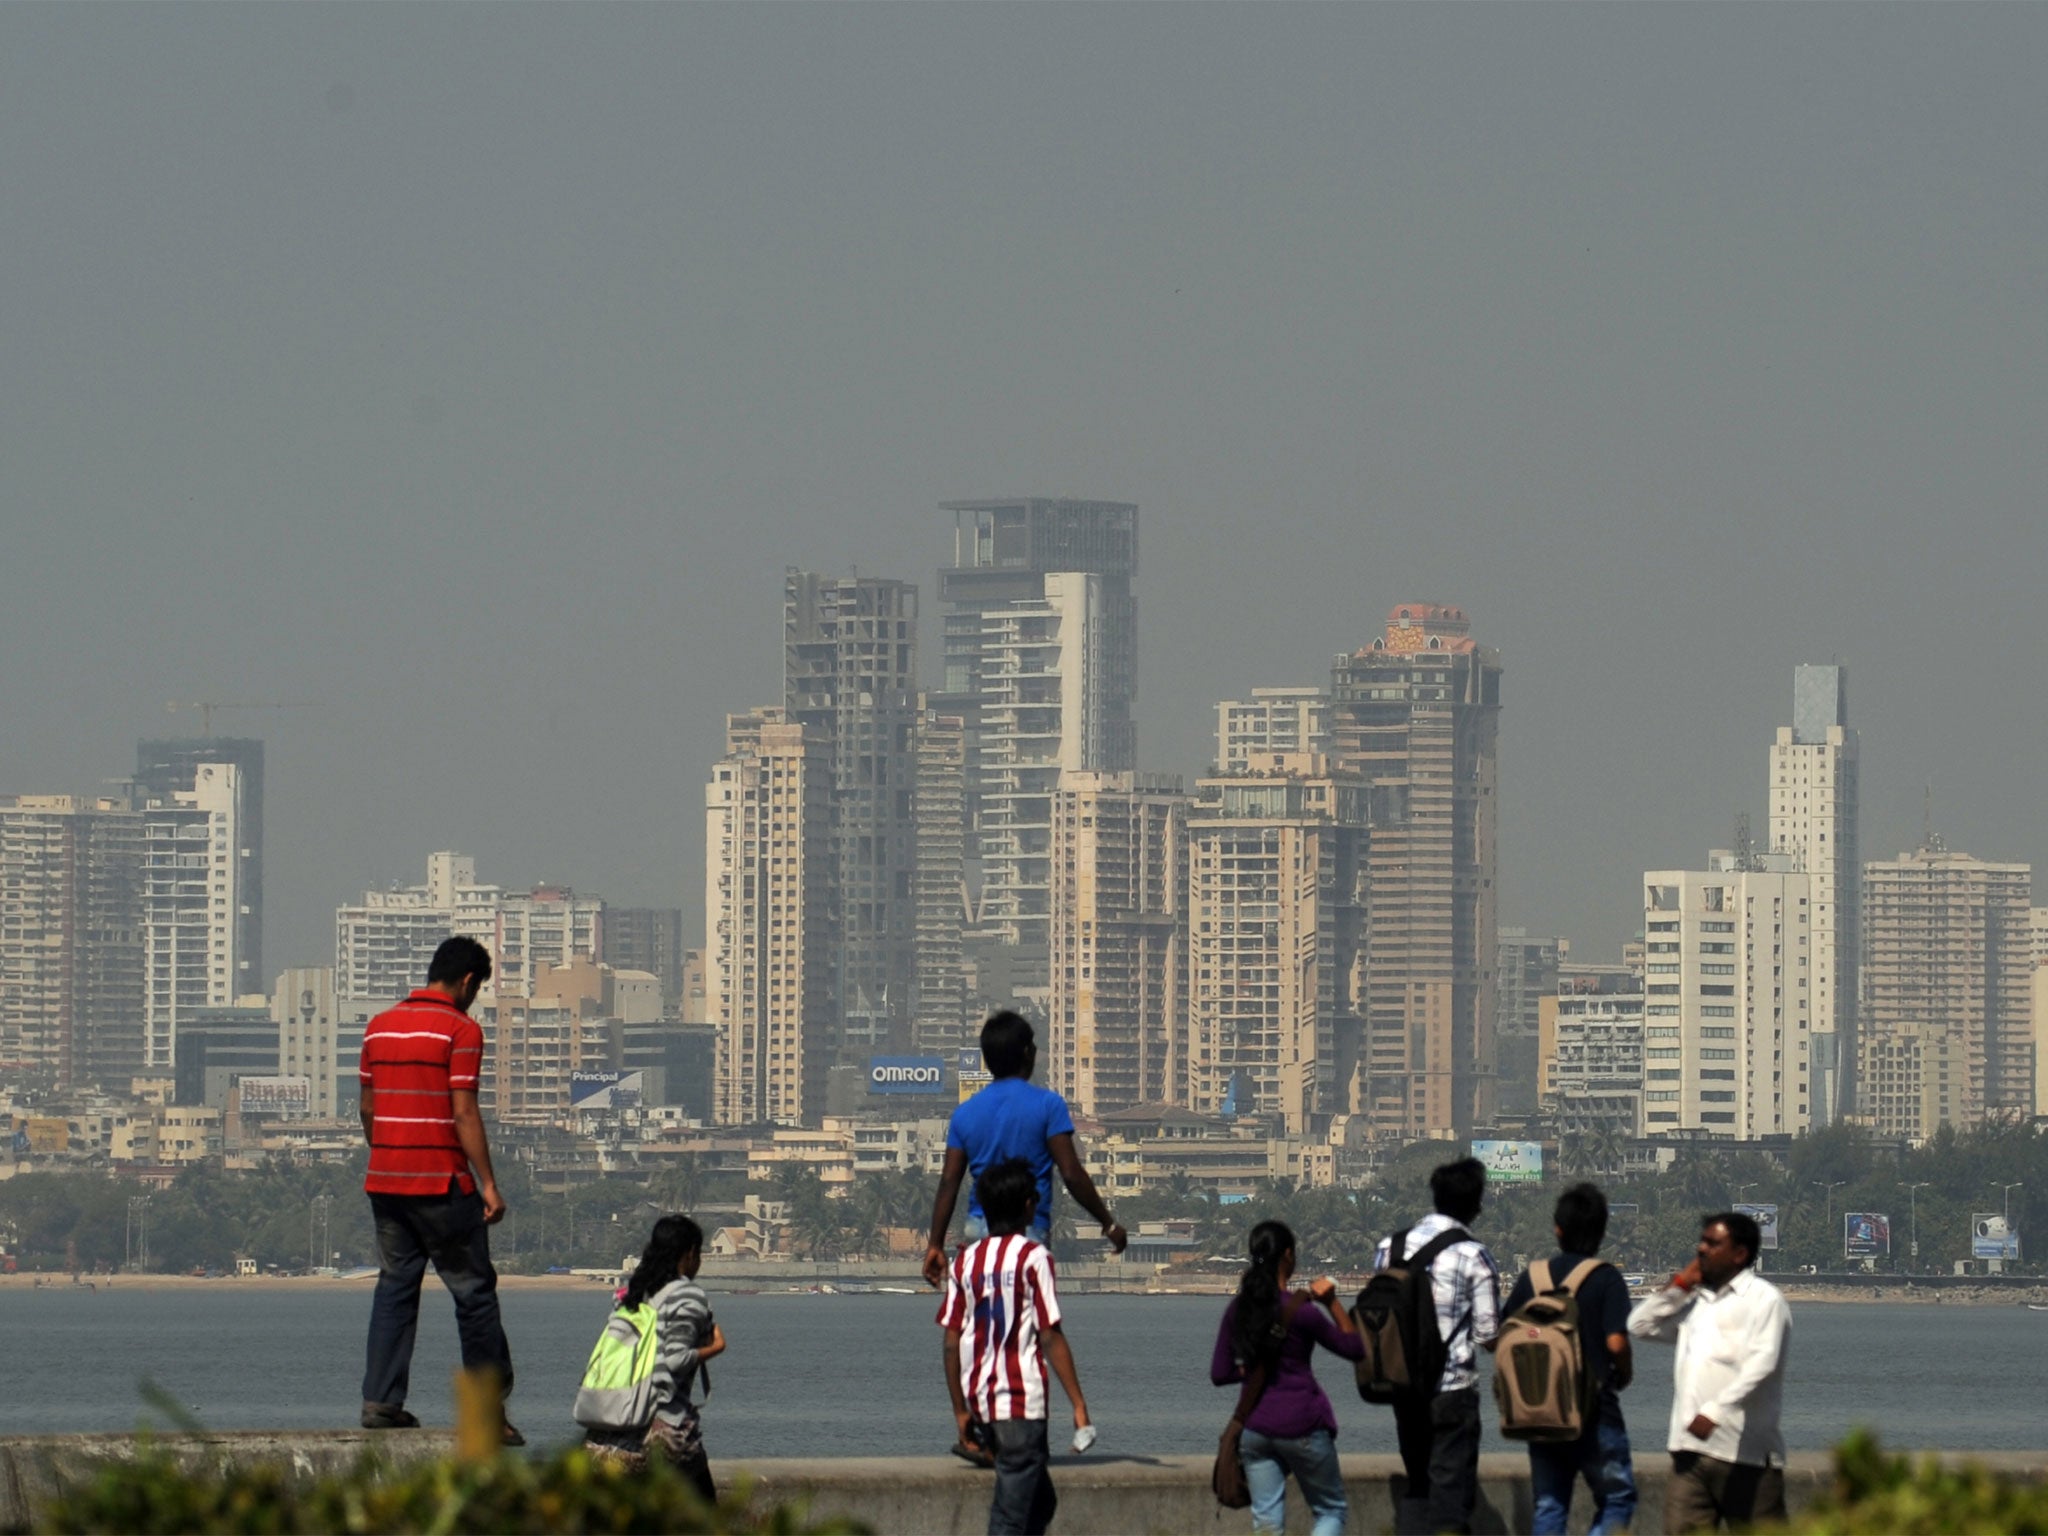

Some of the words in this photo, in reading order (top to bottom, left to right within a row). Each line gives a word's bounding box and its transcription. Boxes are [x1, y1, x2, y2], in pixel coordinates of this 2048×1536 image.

[572, 1071, 619, 1083] Principal
[872, 1066, 940, 1082] OMRON
[243, 1080, 307, 1100] Binani
